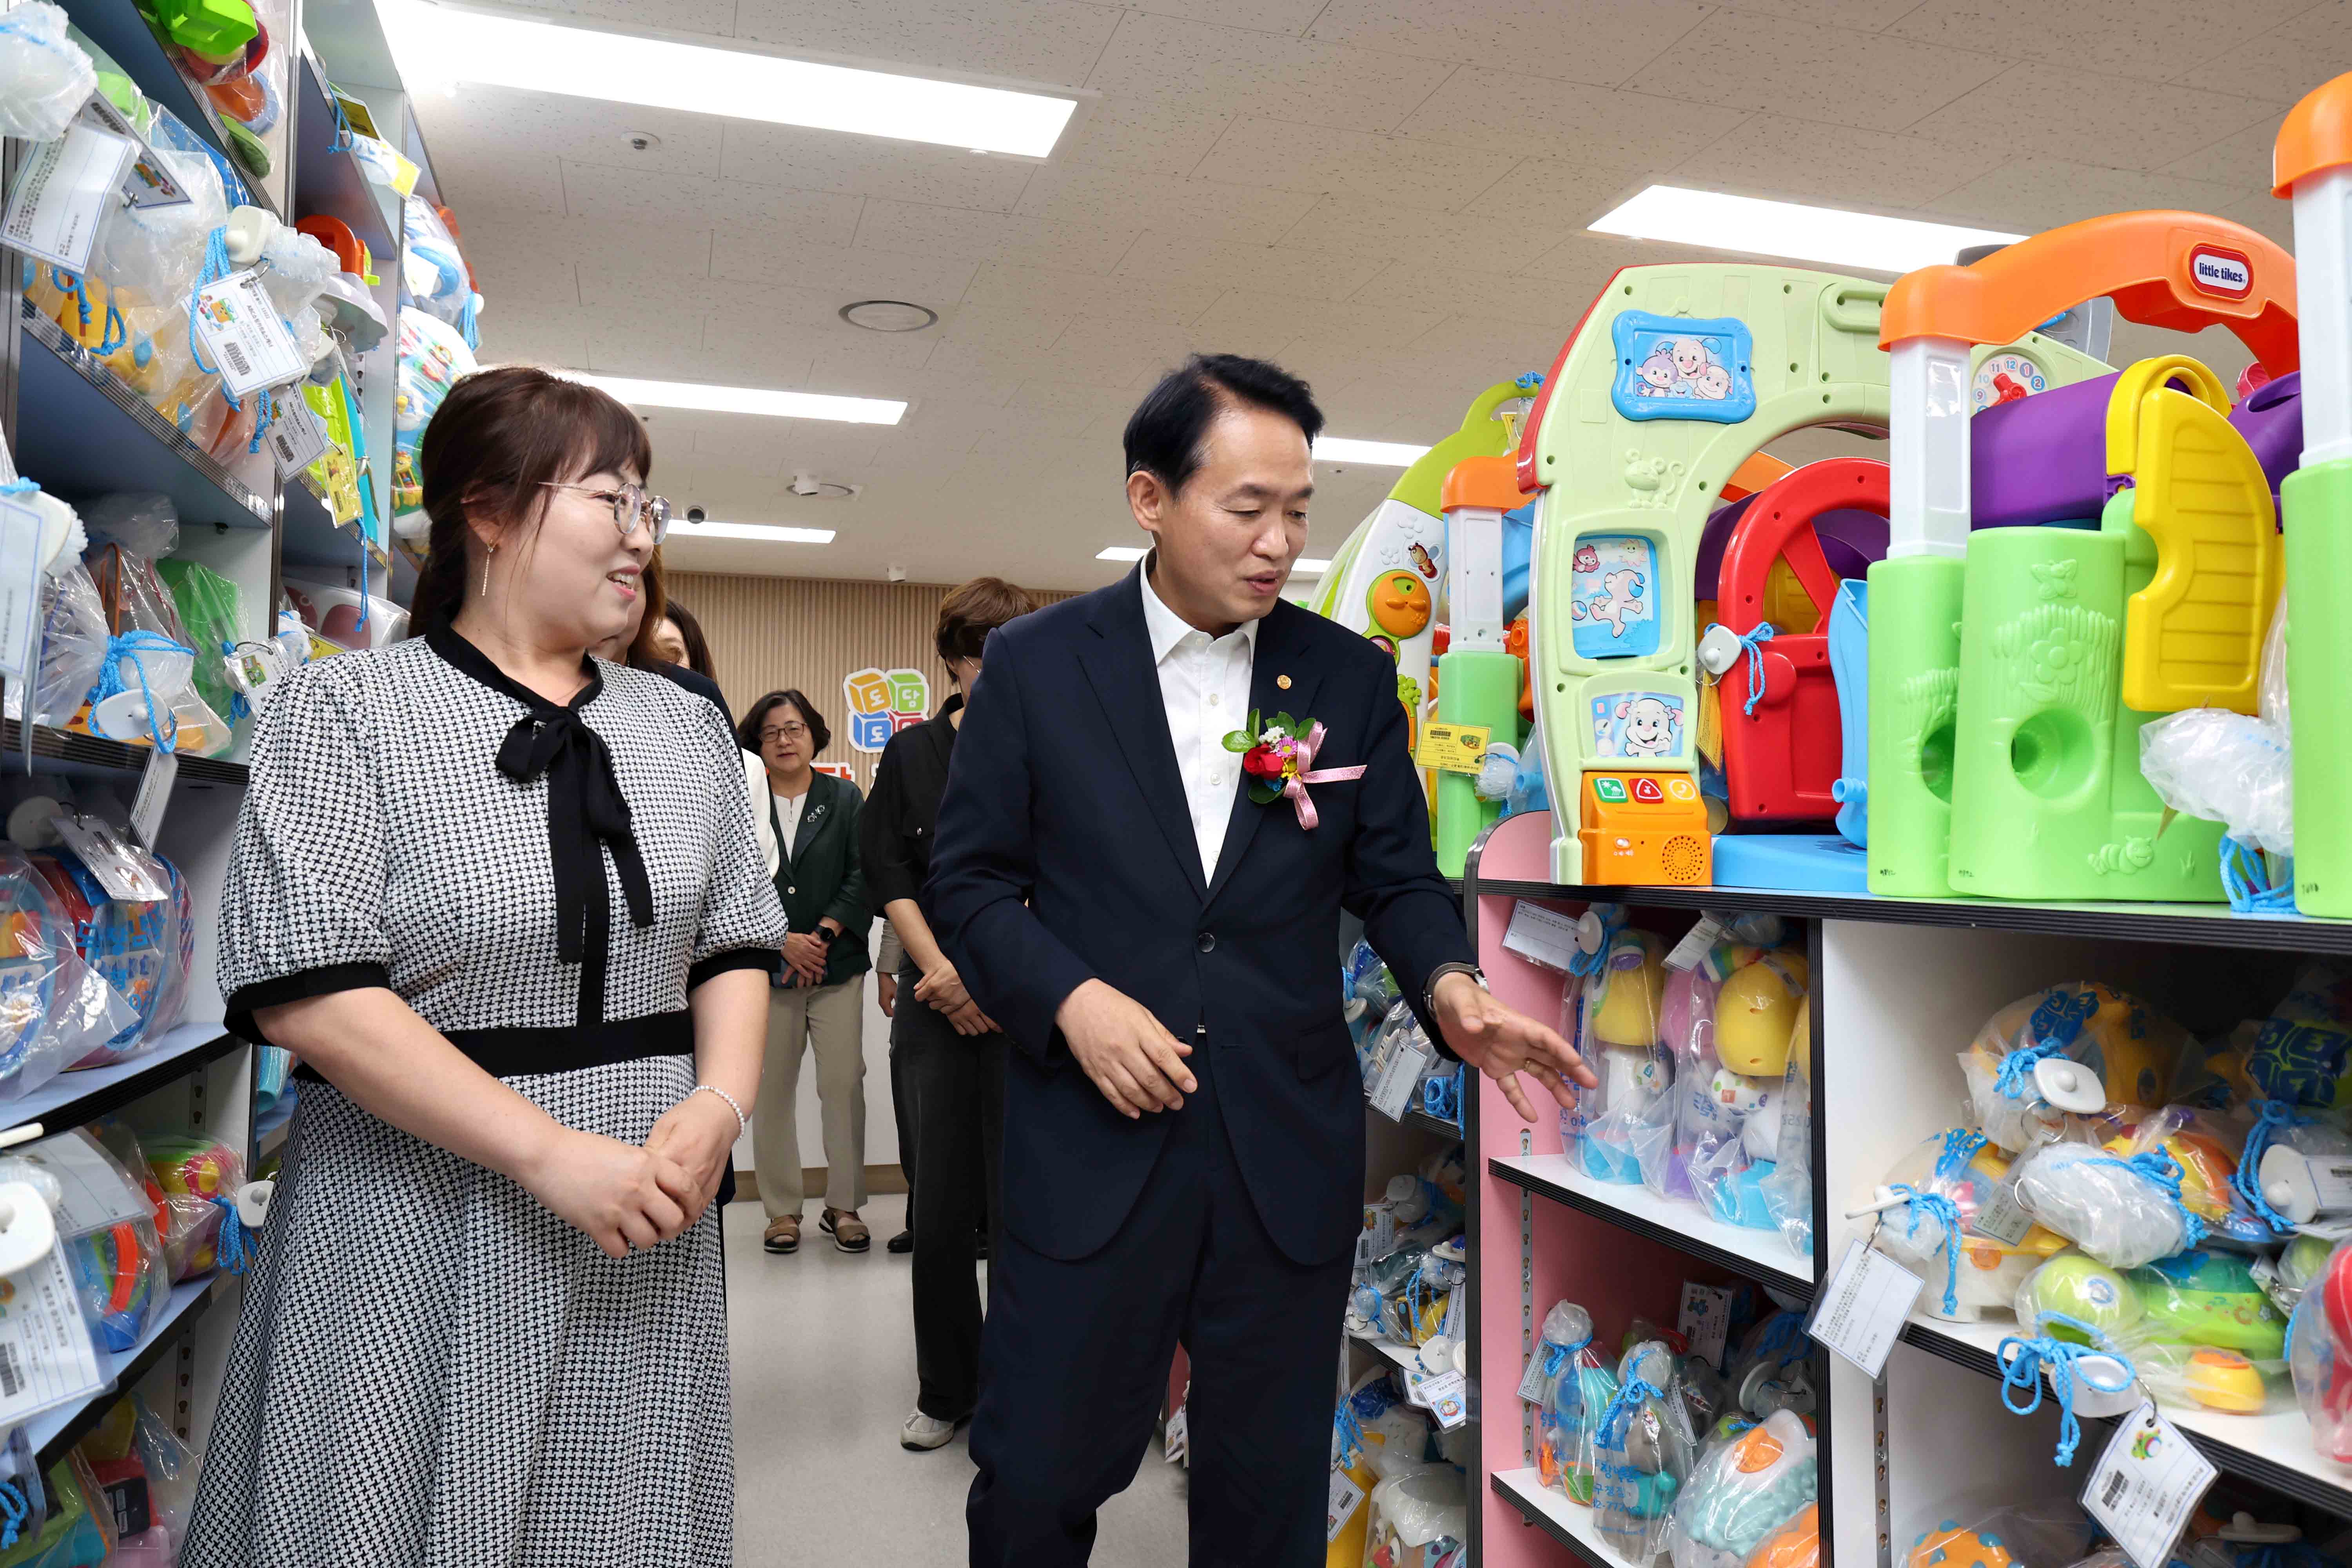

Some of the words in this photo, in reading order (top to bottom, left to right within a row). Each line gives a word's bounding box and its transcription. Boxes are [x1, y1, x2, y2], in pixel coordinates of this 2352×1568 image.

[2200, 262, 2220, 278] little
[2221, 267, 2243, 283] tikes
[1991, 363, 2000, 372] 11
[2006, 360, 2016, 370] 12
[1978, 375, 1989, 383] 10
[2034, 378, 2042, 388] 2
[1977, 391, 1984, 400] 9
